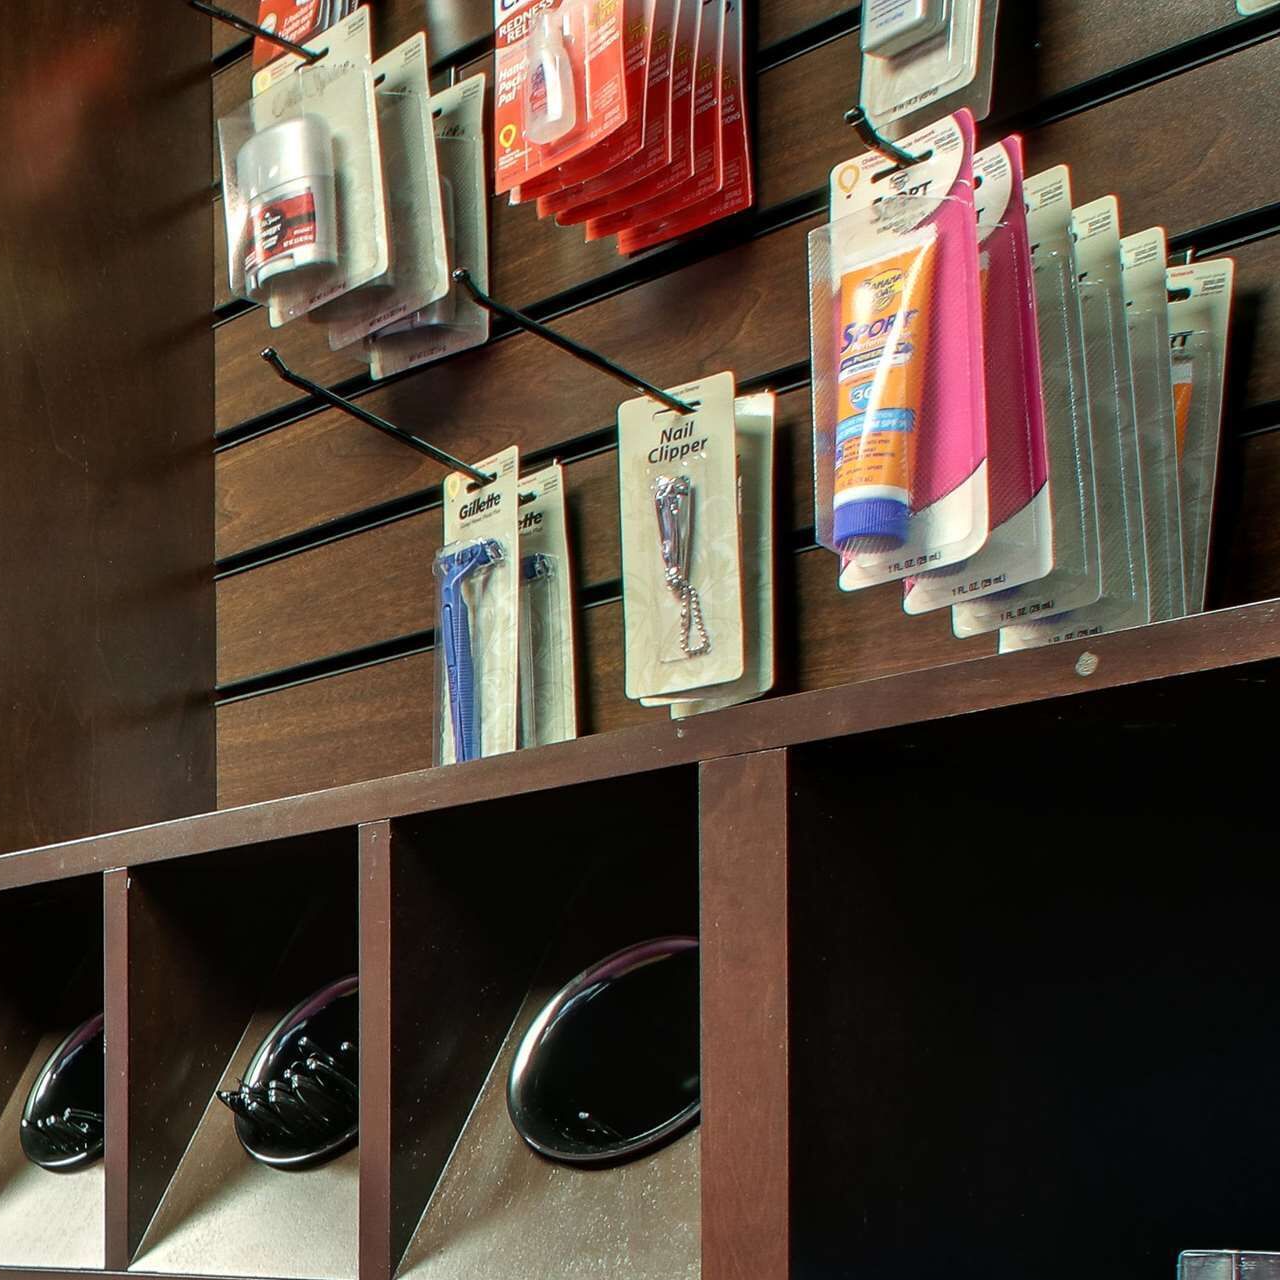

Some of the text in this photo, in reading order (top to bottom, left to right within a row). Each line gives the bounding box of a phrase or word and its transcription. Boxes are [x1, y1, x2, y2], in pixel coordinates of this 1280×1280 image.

[659, 421, 695, 446] Nail
[647, 436, 709, 466] Clipper
[459, 493, 501, 521] Gillette
